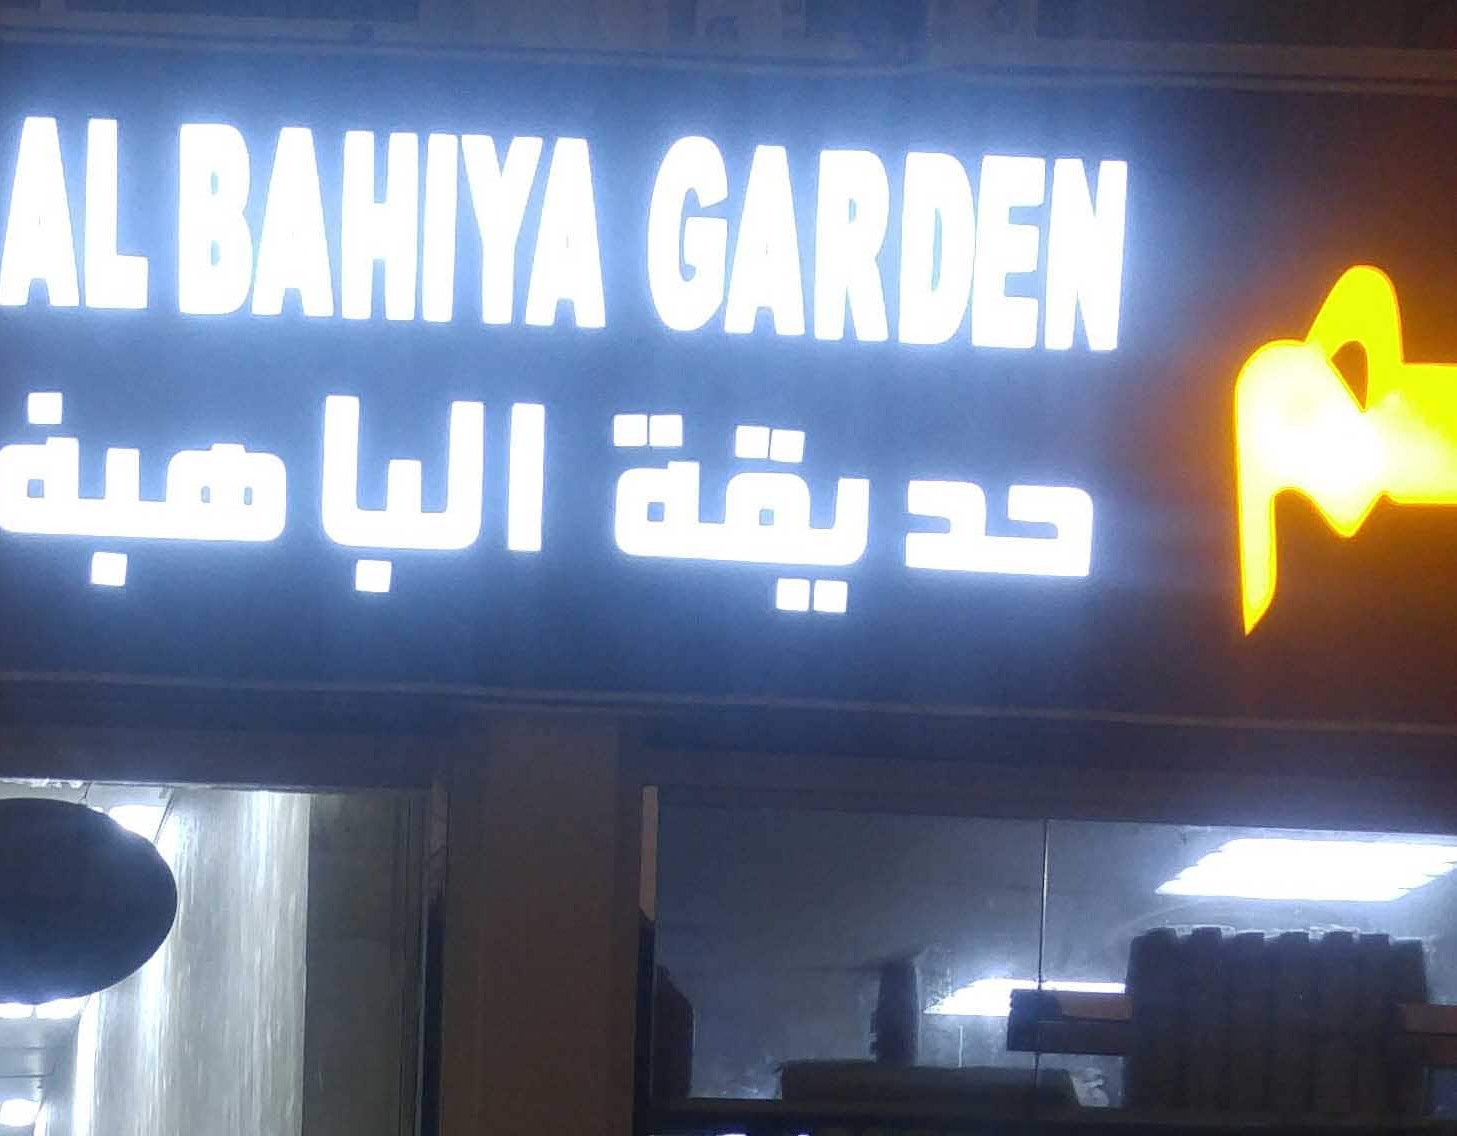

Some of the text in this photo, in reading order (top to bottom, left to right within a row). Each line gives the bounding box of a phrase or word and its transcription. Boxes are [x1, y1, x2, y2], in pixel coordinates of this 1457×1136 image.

[177, 123, 606, 329] BAHIYA
[647, 135, 1128, 352] GARDEN
[612, 413, 1095, 614] حديقة
